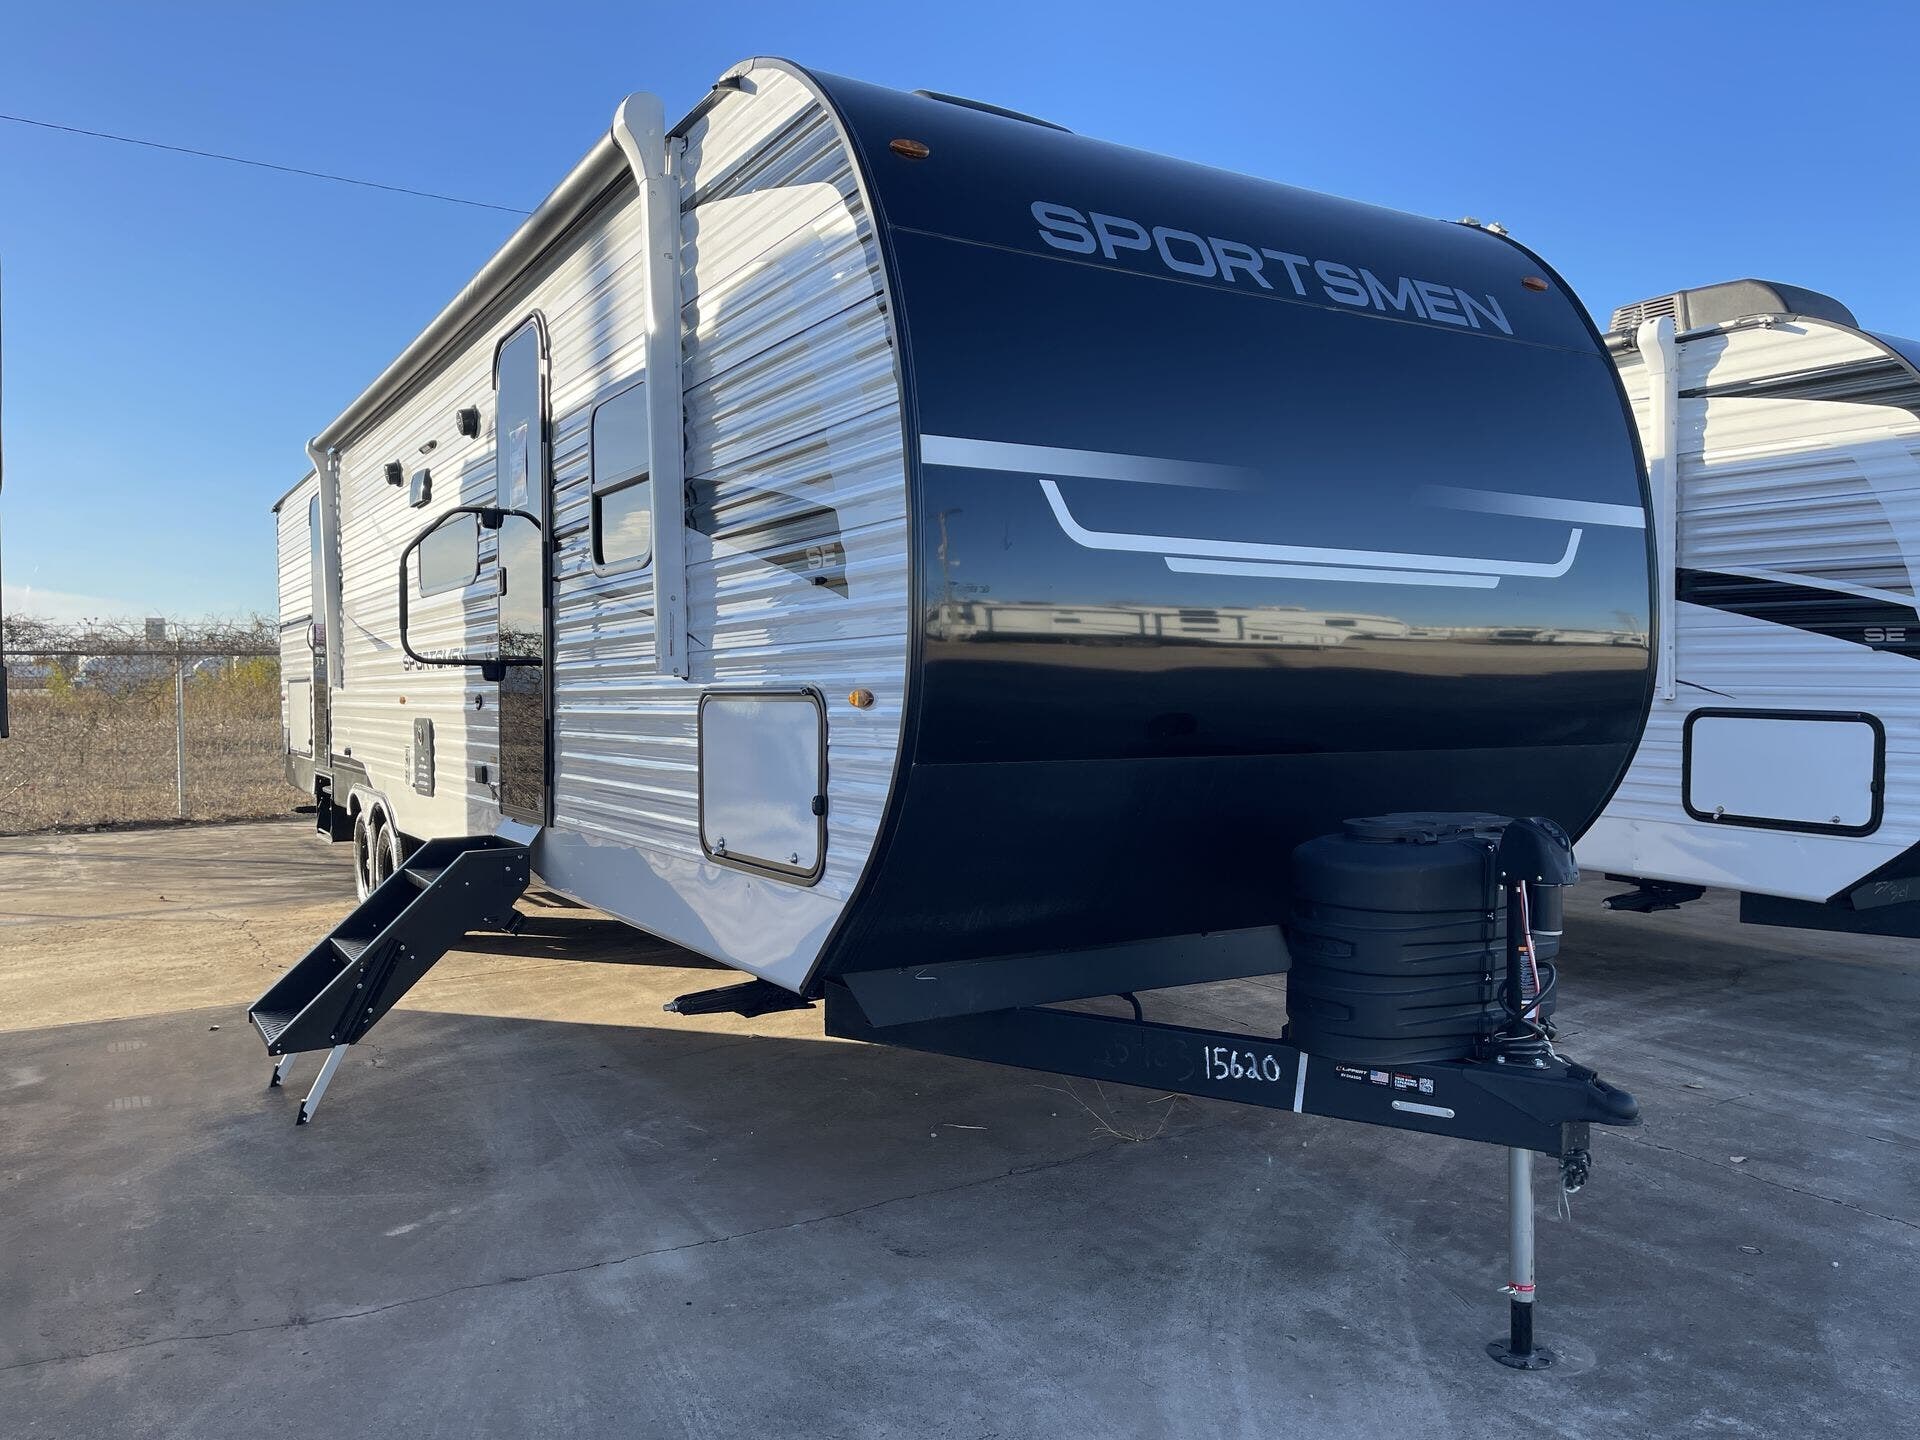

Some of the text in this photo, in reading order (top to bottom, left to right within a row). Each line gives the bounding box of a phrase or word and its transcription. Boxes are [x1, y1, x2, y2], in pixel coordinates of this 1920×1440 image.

[1030, 200, 1514, 335] SPORTSMEN
[806, 543, 837, 570] SE
[1863, 627, 1906, 643] SE
[1204, 1046, 1281, 1081] 15620
